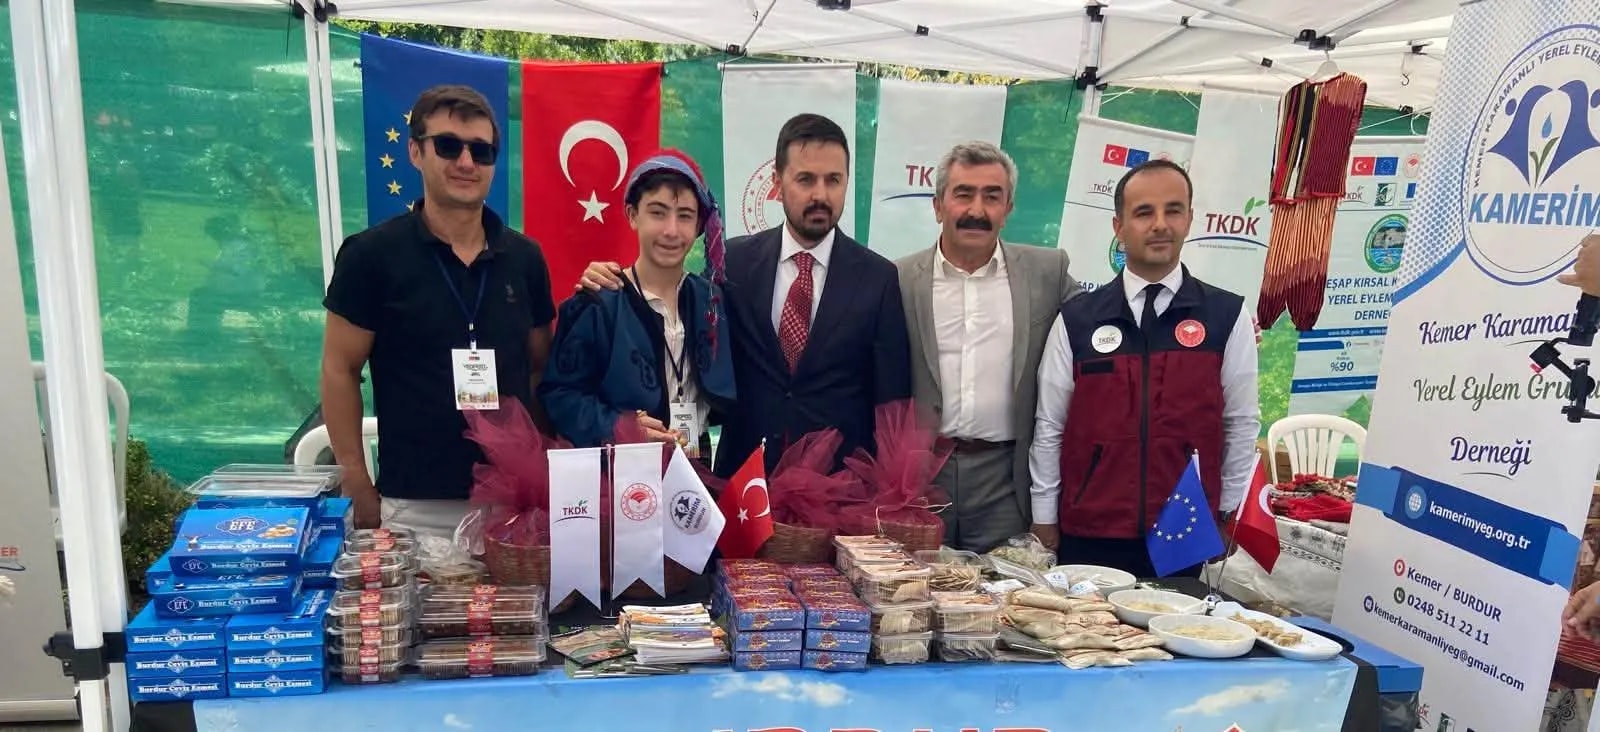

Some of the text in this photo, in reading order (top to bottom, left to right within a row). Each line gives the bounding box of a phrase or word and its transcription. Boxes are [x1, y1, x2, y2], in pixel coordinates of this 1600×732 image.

[1539, 45, 1570, 64] YEREL
[906, 165, 934, 187] TK
[1093, 183, 1113, 193] TKDK
[1468, 184, 1600, 226] KAMERİM
[1206, 213, 1261, 236] TKDK
[1354, 277, 1389, 288] KIRSAL
[1328, 295, 1358, 305] YEREL
[1354, 310, 1391, 320] DERNE
[1419, 321, 1476, 345] Kemer
[1330, 361, 1354, 372] %90
[1413, 375, 1456, 401] Yerel
[1461, 373, 1521, 411] Eylem
[1451, 437, 1532, 475] Derneği
[563, 506, 588, 516] TKDK
[230, 521, 257, 531] EFE
[1430, 501, 1531, 549] kamerimyeg.org.tr
[1, 547, 18, 557] ER
[1407, 567, 1502, 622] Kemer / BURDUR
[1407, 594, 1489, 646] 0248 511 22 11
[1374, 602, 1525, 691] kemerkaramanliyeg@gmail.com
